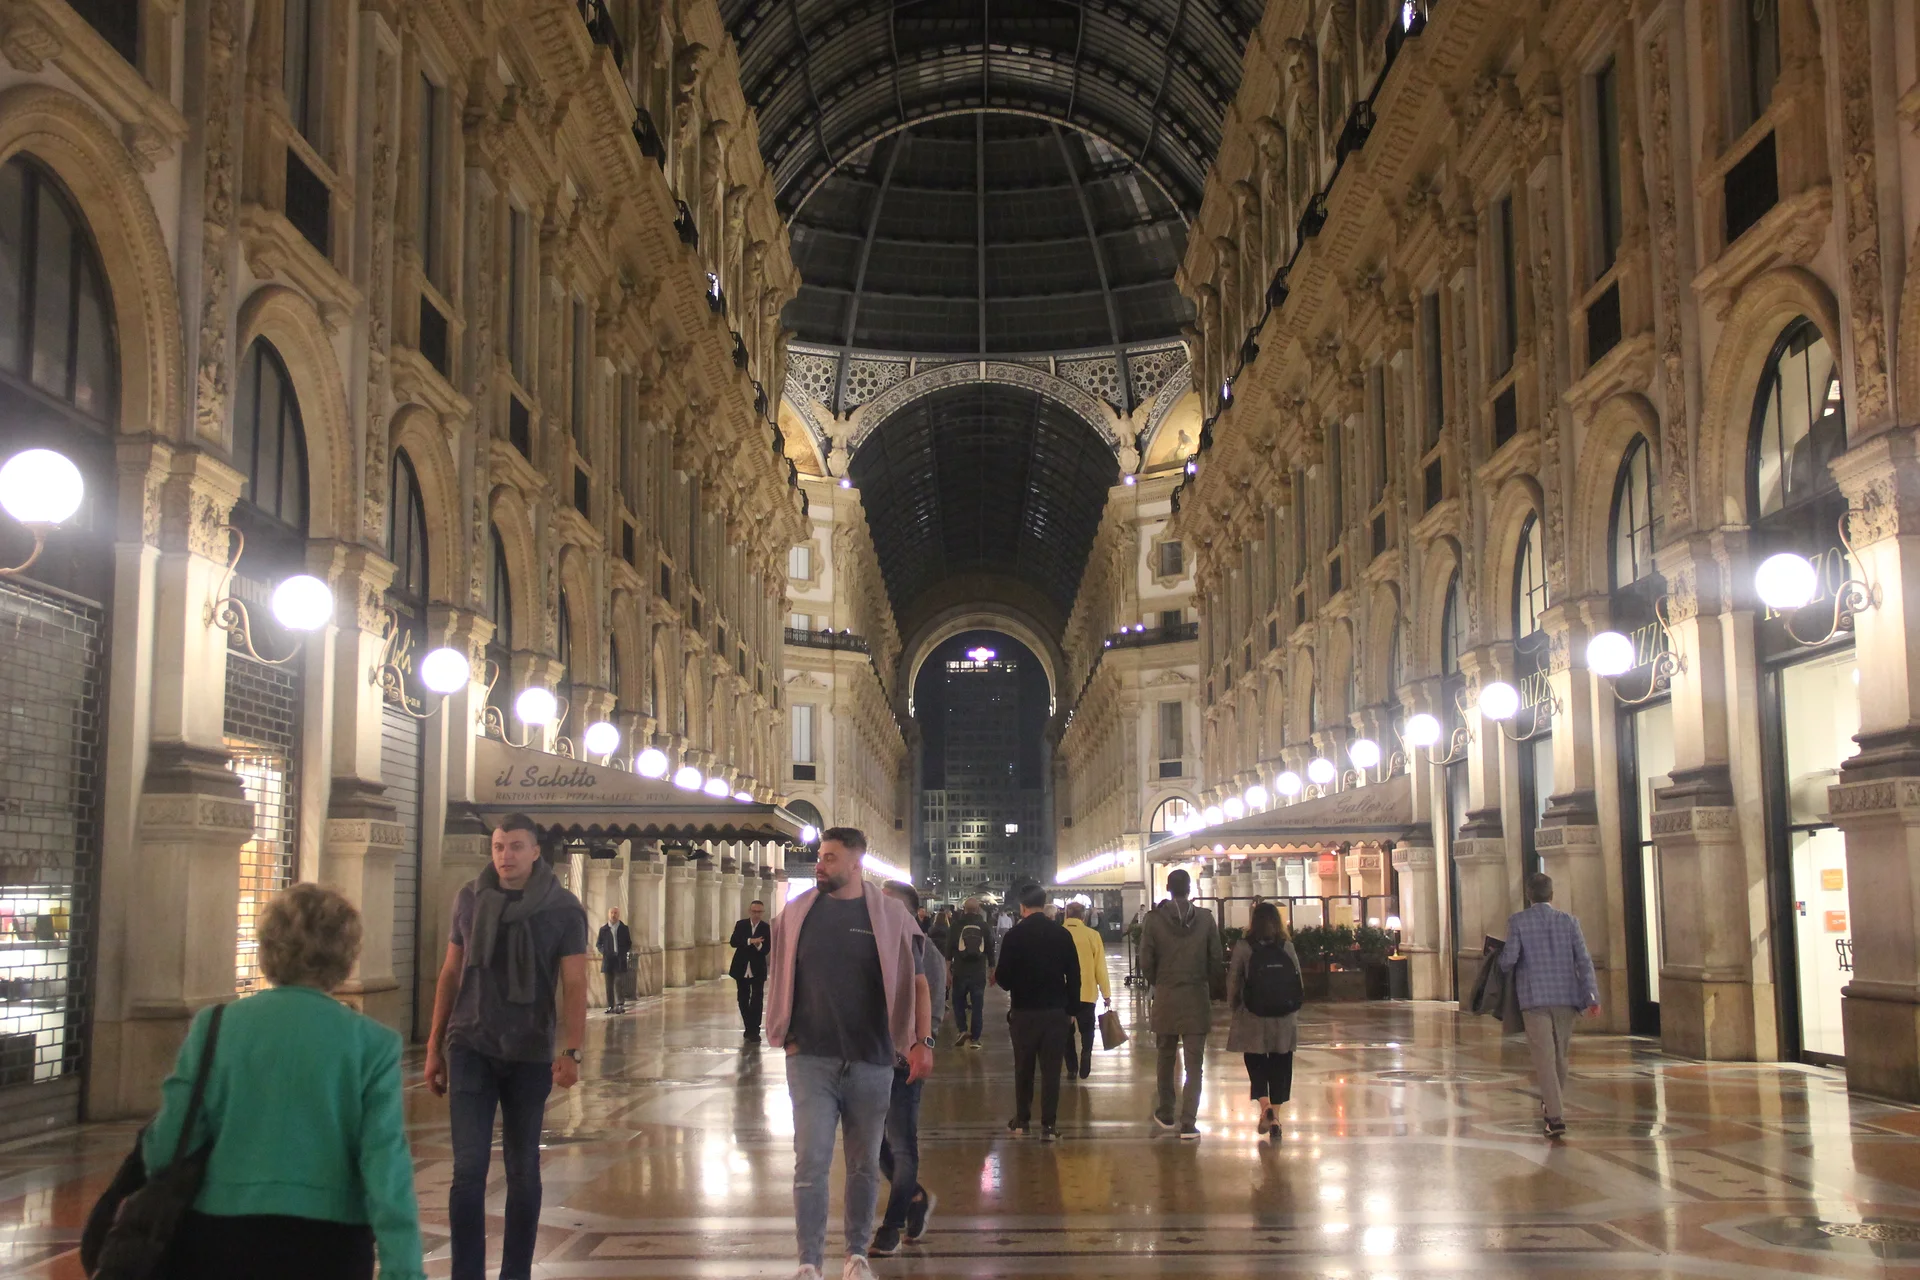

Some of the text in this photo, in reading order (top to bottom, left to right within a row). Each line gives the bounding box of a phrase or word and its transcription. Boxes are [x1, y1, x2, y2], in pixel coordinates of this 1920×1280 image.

[494, 764, 598, 788] il Salotto
[494, 791, 557, 801] RISTORANTE
[566, 791, 595, 801] PIZZA
[646, 791, 673, 801] WINE
[1332, 794, 1396, 814] Galleria
